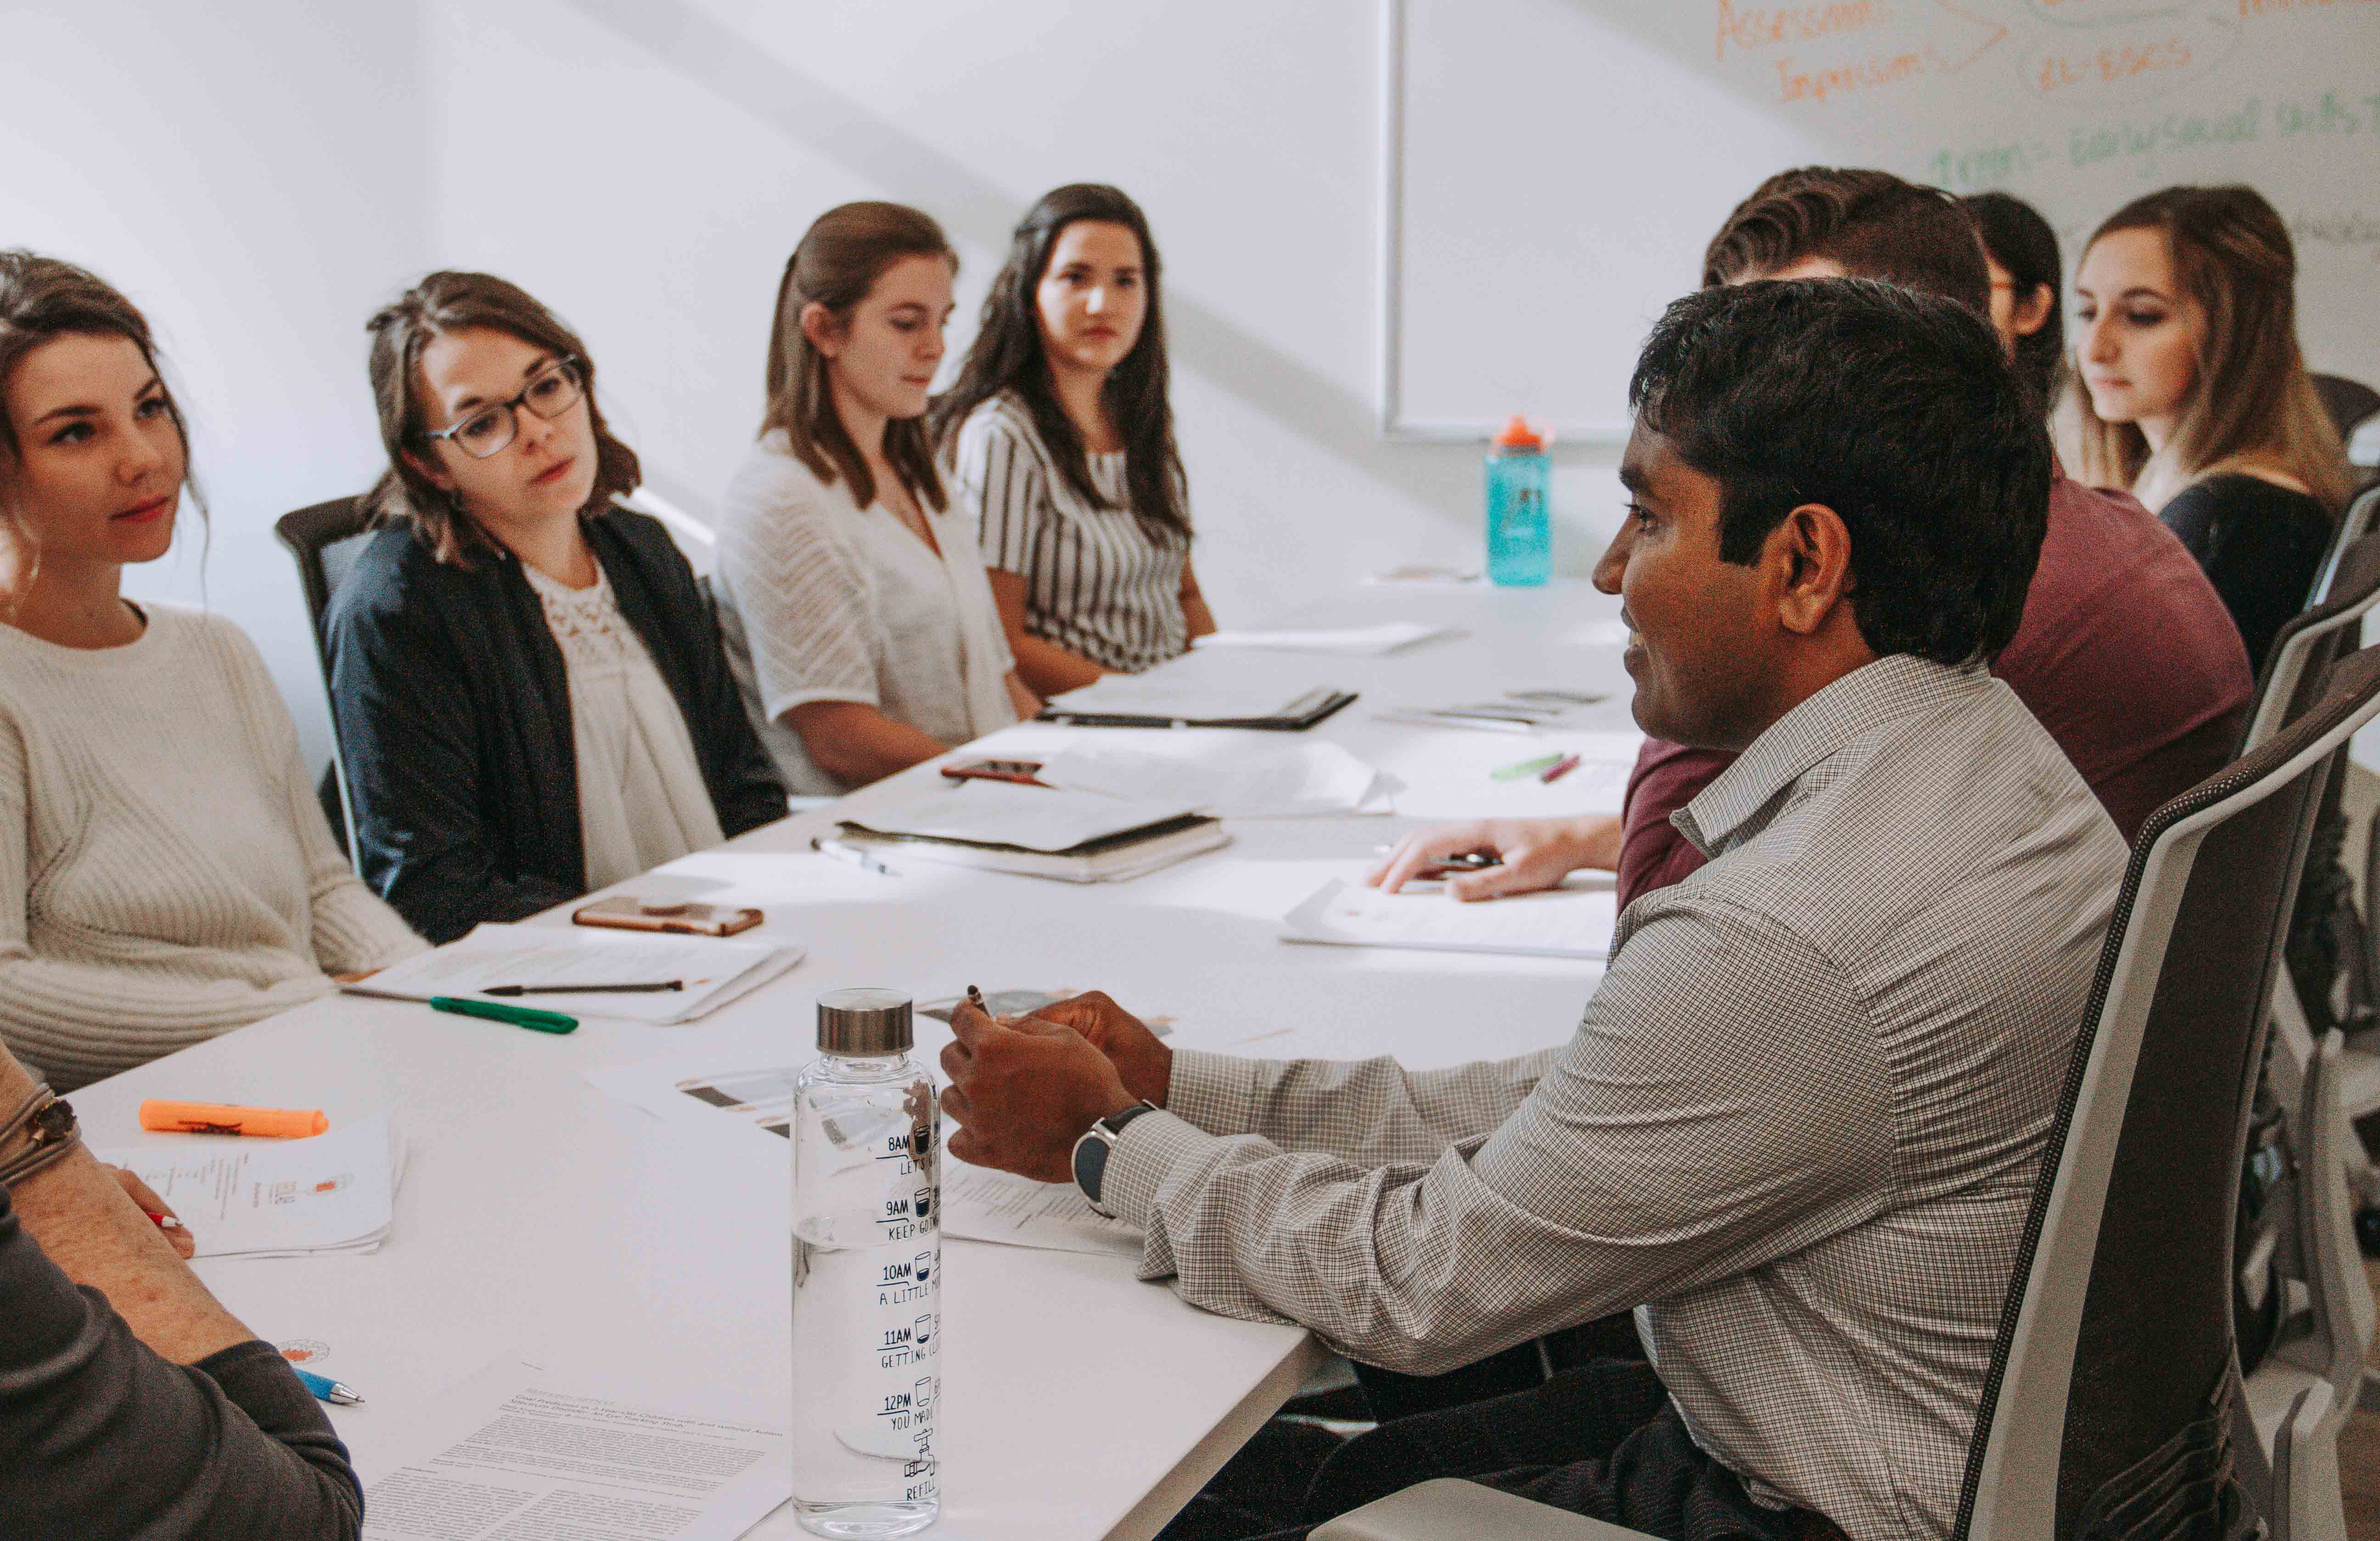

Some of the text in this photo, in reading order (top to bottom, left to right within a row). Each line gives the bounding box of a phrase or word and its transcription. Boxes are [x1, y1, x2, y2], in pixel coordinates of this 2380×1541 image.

[888, 1135, 910, 1151] 8AM
[887, 1199, 909, 1215] 9AM
[889, 1224, 915, 1241] KEEP
[883, 1262, 911, 1280] 10AM
[880, 1293, 887, 1305] A
[894, 1282, 929, 1304] LITTLE
[885, 1327, 911, 1345] 11AM
[881, 1347, 926, 1369] GETTING
[885, 1392, 911, 1411] 12PM
[891, 1415, 909, 1431] YOU
[907, 1478, 936, 1501] REFILL
